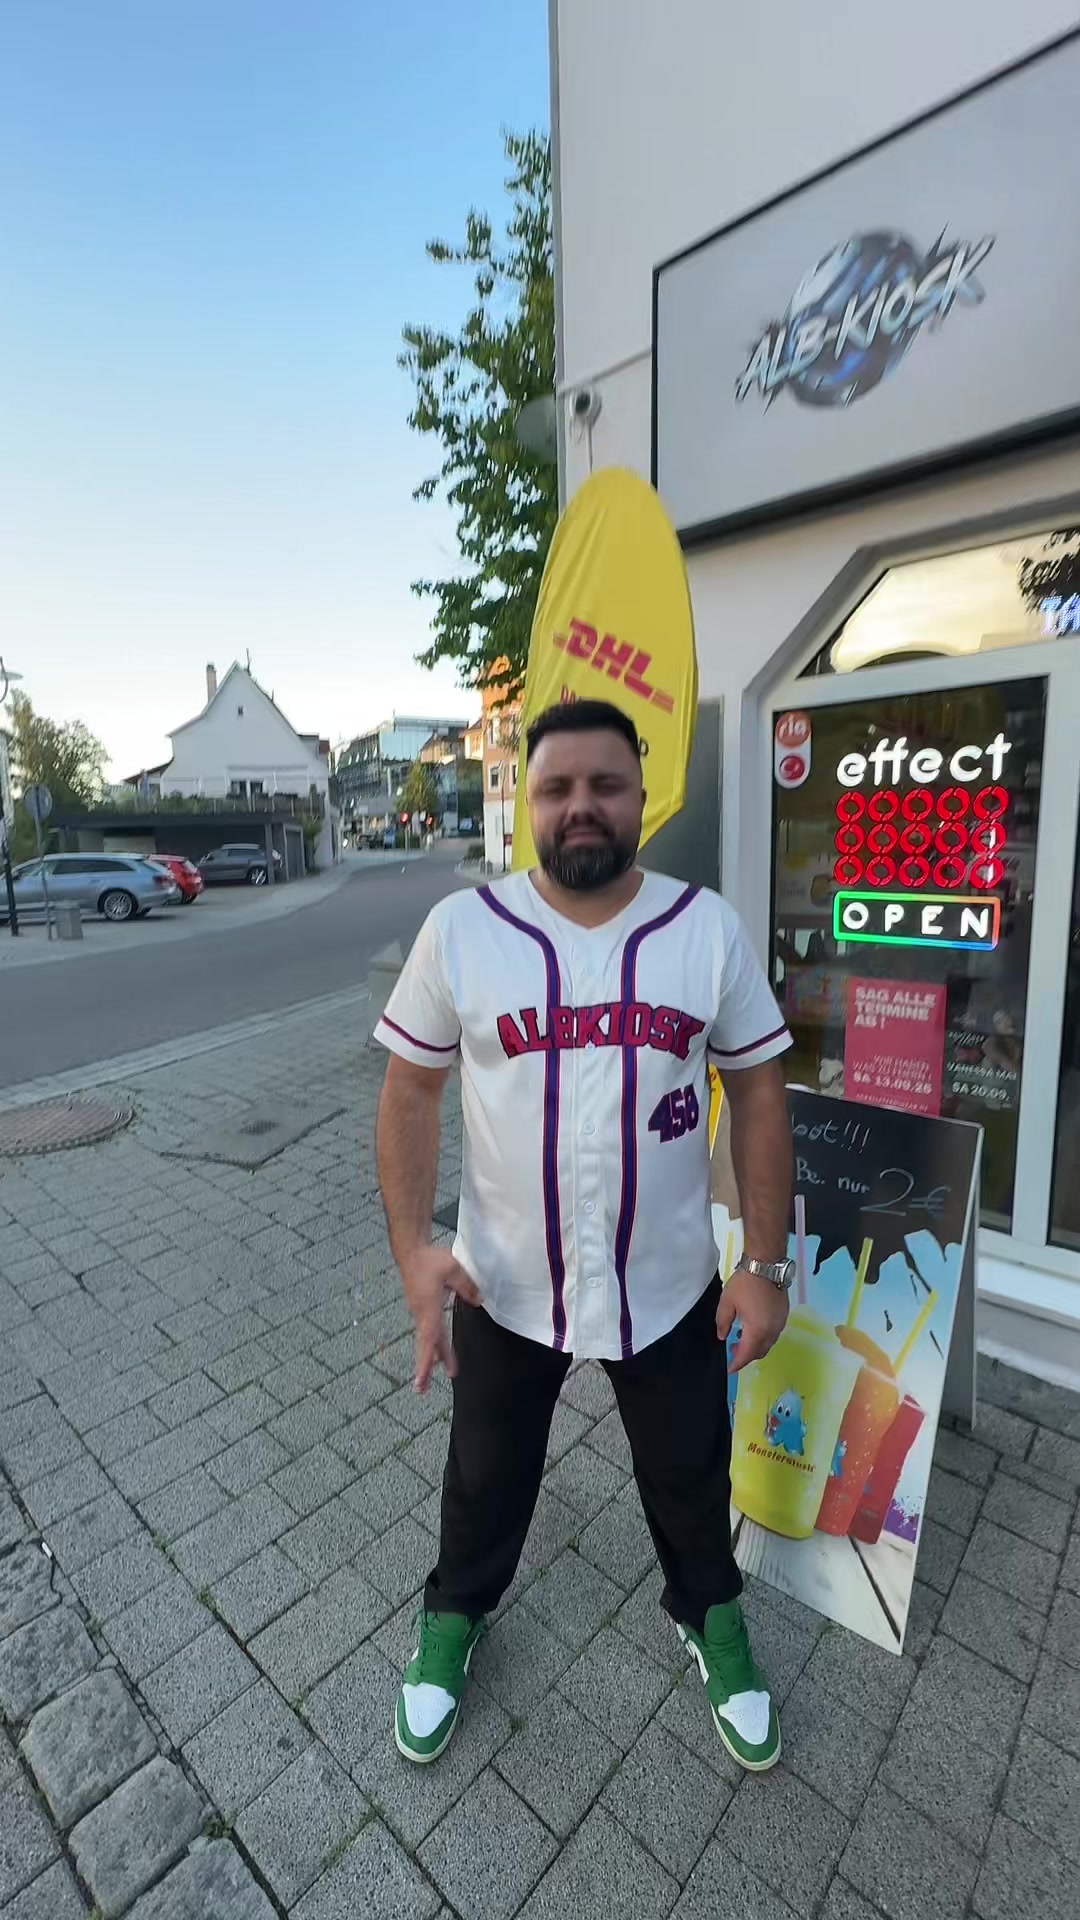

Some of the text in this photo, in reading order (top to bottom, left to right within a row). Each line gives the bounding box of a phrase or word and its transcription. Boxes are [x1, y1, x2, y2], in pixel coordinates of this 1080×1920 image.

[735, 230, 997, 402] ALB-KIOSK
[562, 616, 656, 701] DHL
[836, 732, 1013, 788] effect
[841, 901, 990, 939] OPEN
[855, 986, 937, 1008] SAG ALLE
[855, 1001, 930, 1021] TERMINE
[496, 1001, 706, 1061] ALBKIOSK
[952, 1081, 969, 1096] SA
[648, 1083, 700, 1144] 458
[791, 1112, 871, 1154] bot!!!
[838, 1176, 870, 1194] nur
